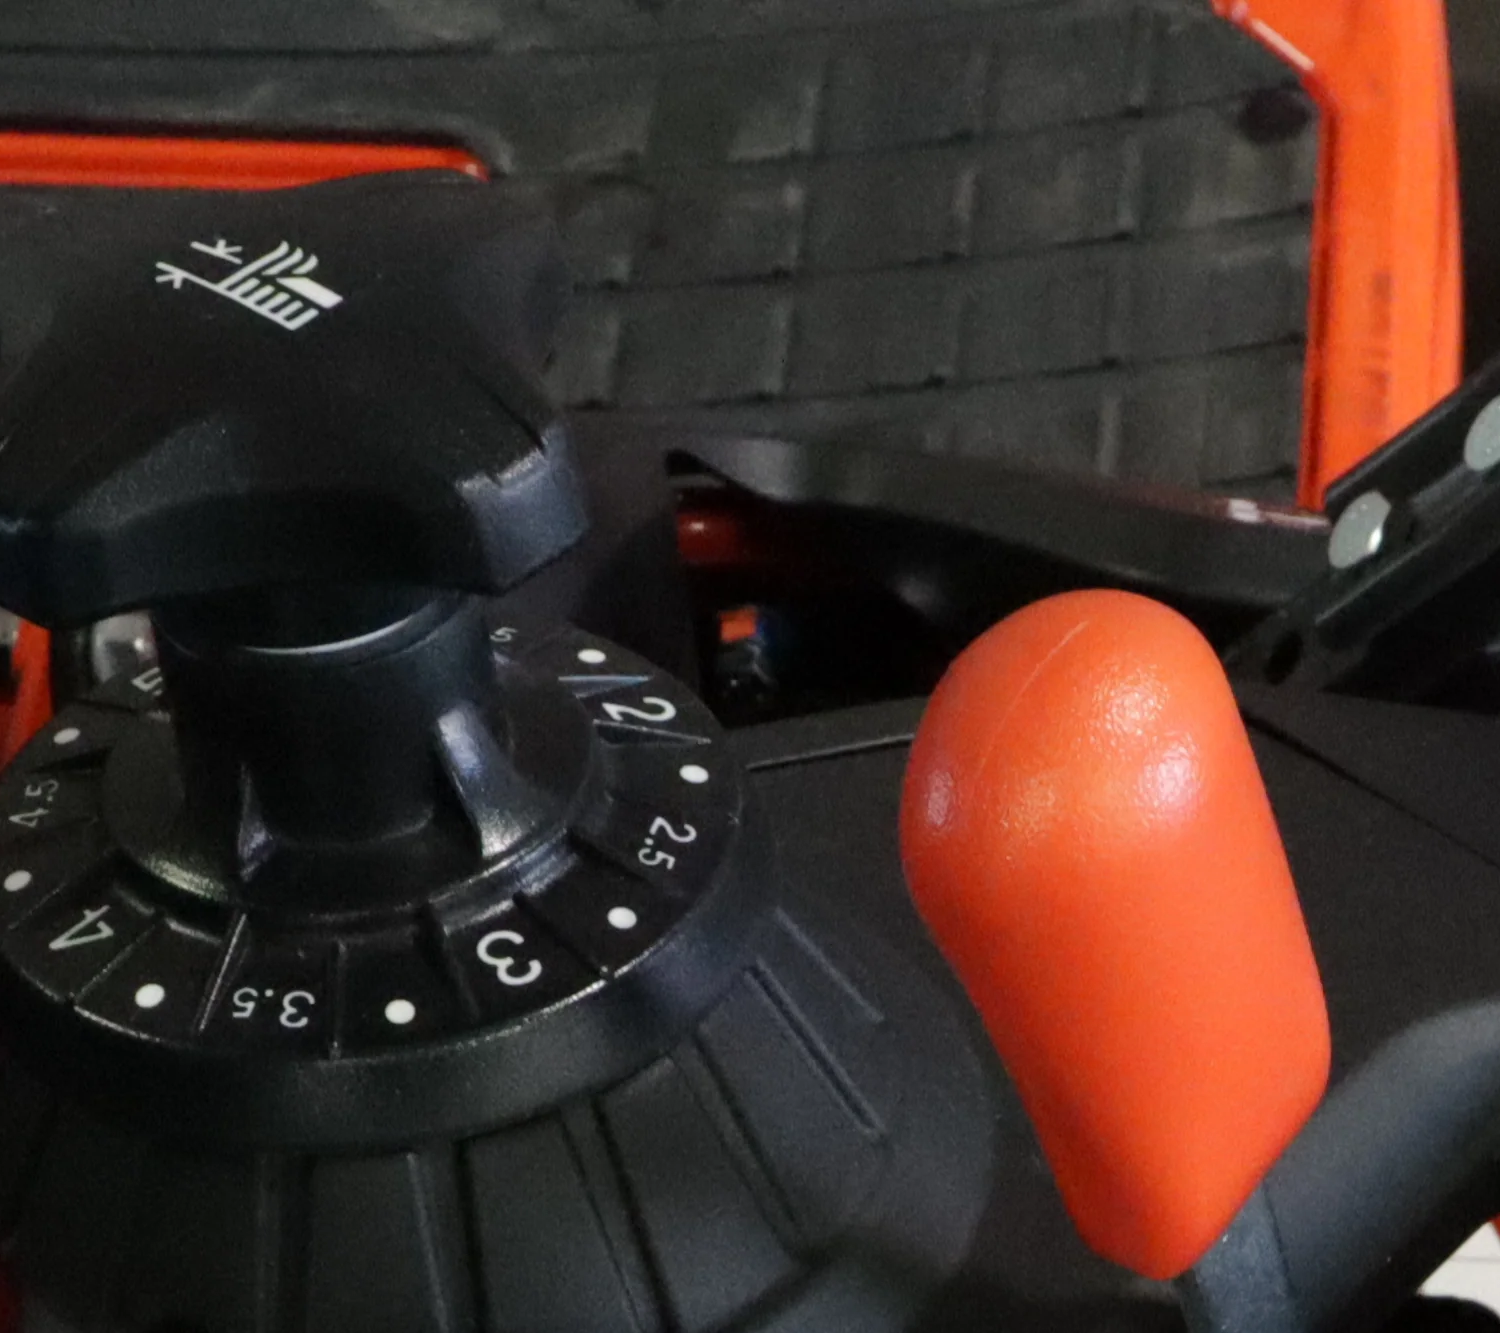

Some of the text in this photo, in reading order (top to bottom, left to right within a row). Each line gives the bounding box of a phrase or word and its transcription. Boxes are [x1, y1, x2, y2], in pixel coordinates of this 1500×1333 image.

[601, 695, 678, 724] 2
[6, 779, 61, 828] 4.5
[637, 815, 698, 871] 2.5
[48, 903, 116, 952] 4
[476, 929, 543, 987] 3
[232, 985, 316, 1029] 3.5
